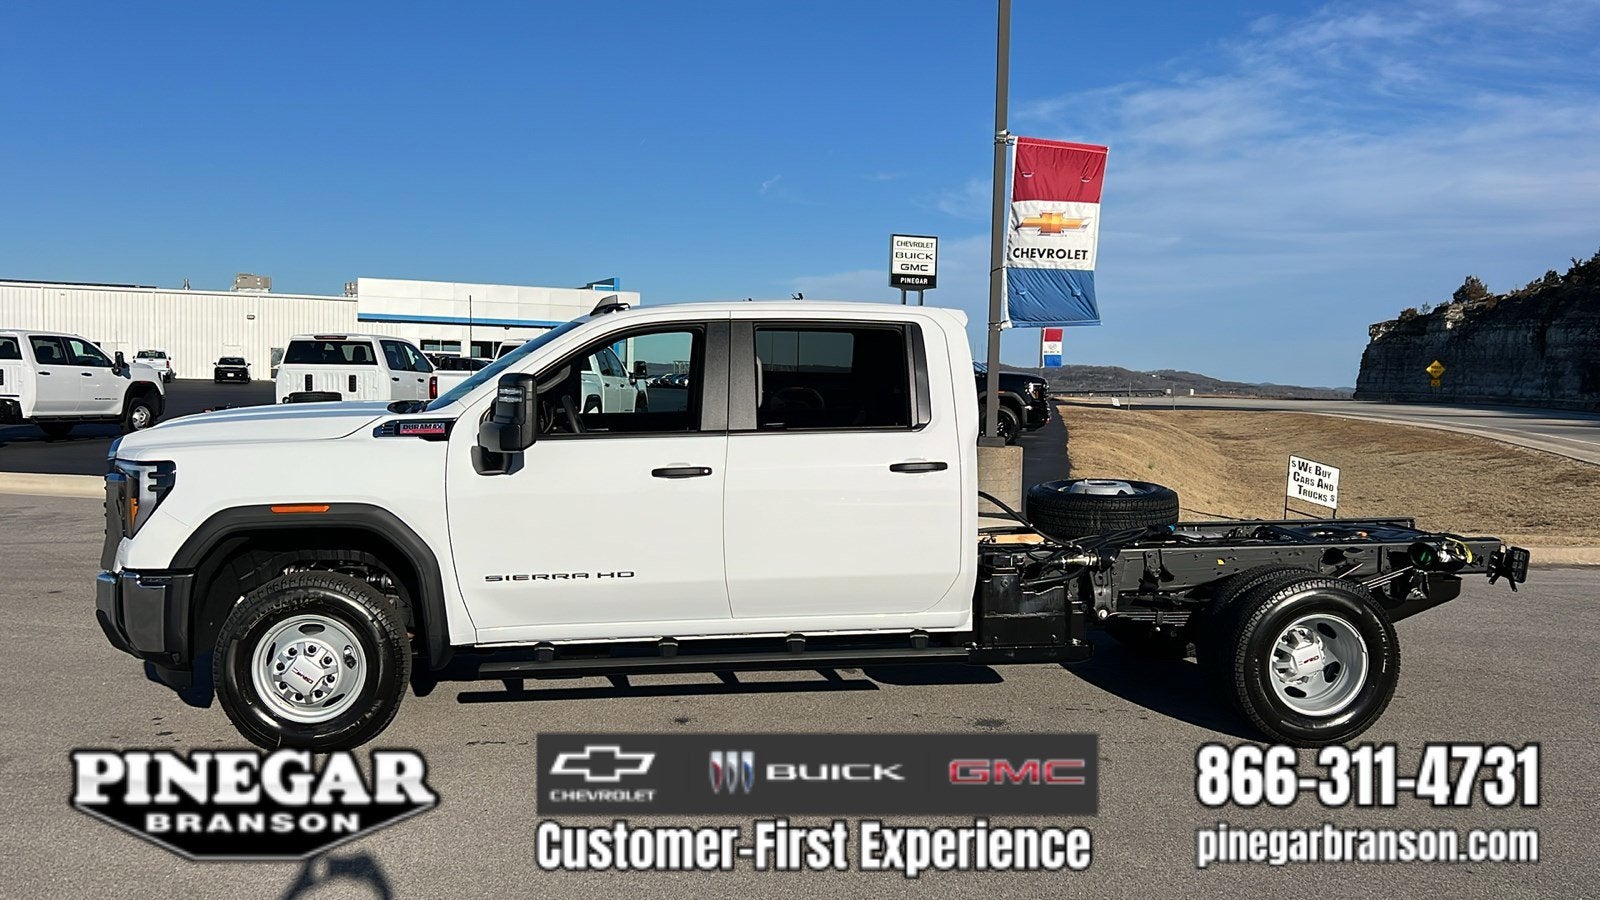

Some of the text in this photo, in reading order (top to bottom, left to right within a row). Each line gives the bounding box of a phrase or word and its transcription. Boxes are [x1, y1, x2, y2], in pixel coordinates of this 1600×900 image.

[896, 240, 934, 249] CHEVROLET
[895, 252, 933, 260] BUICK
[1012, 247, 1088, 260] CHEVROLET
[900, 263, 929, 272] GMC
[900, 277, 928, 285] PINEGAR
[1315, 465, 1331, 479] BUY
[1293, 471, 1334, 492] CARS AND
[1298, 484, 1327, 502] TRUCKS
[485, 571, 634, 582] SIERRA HD
